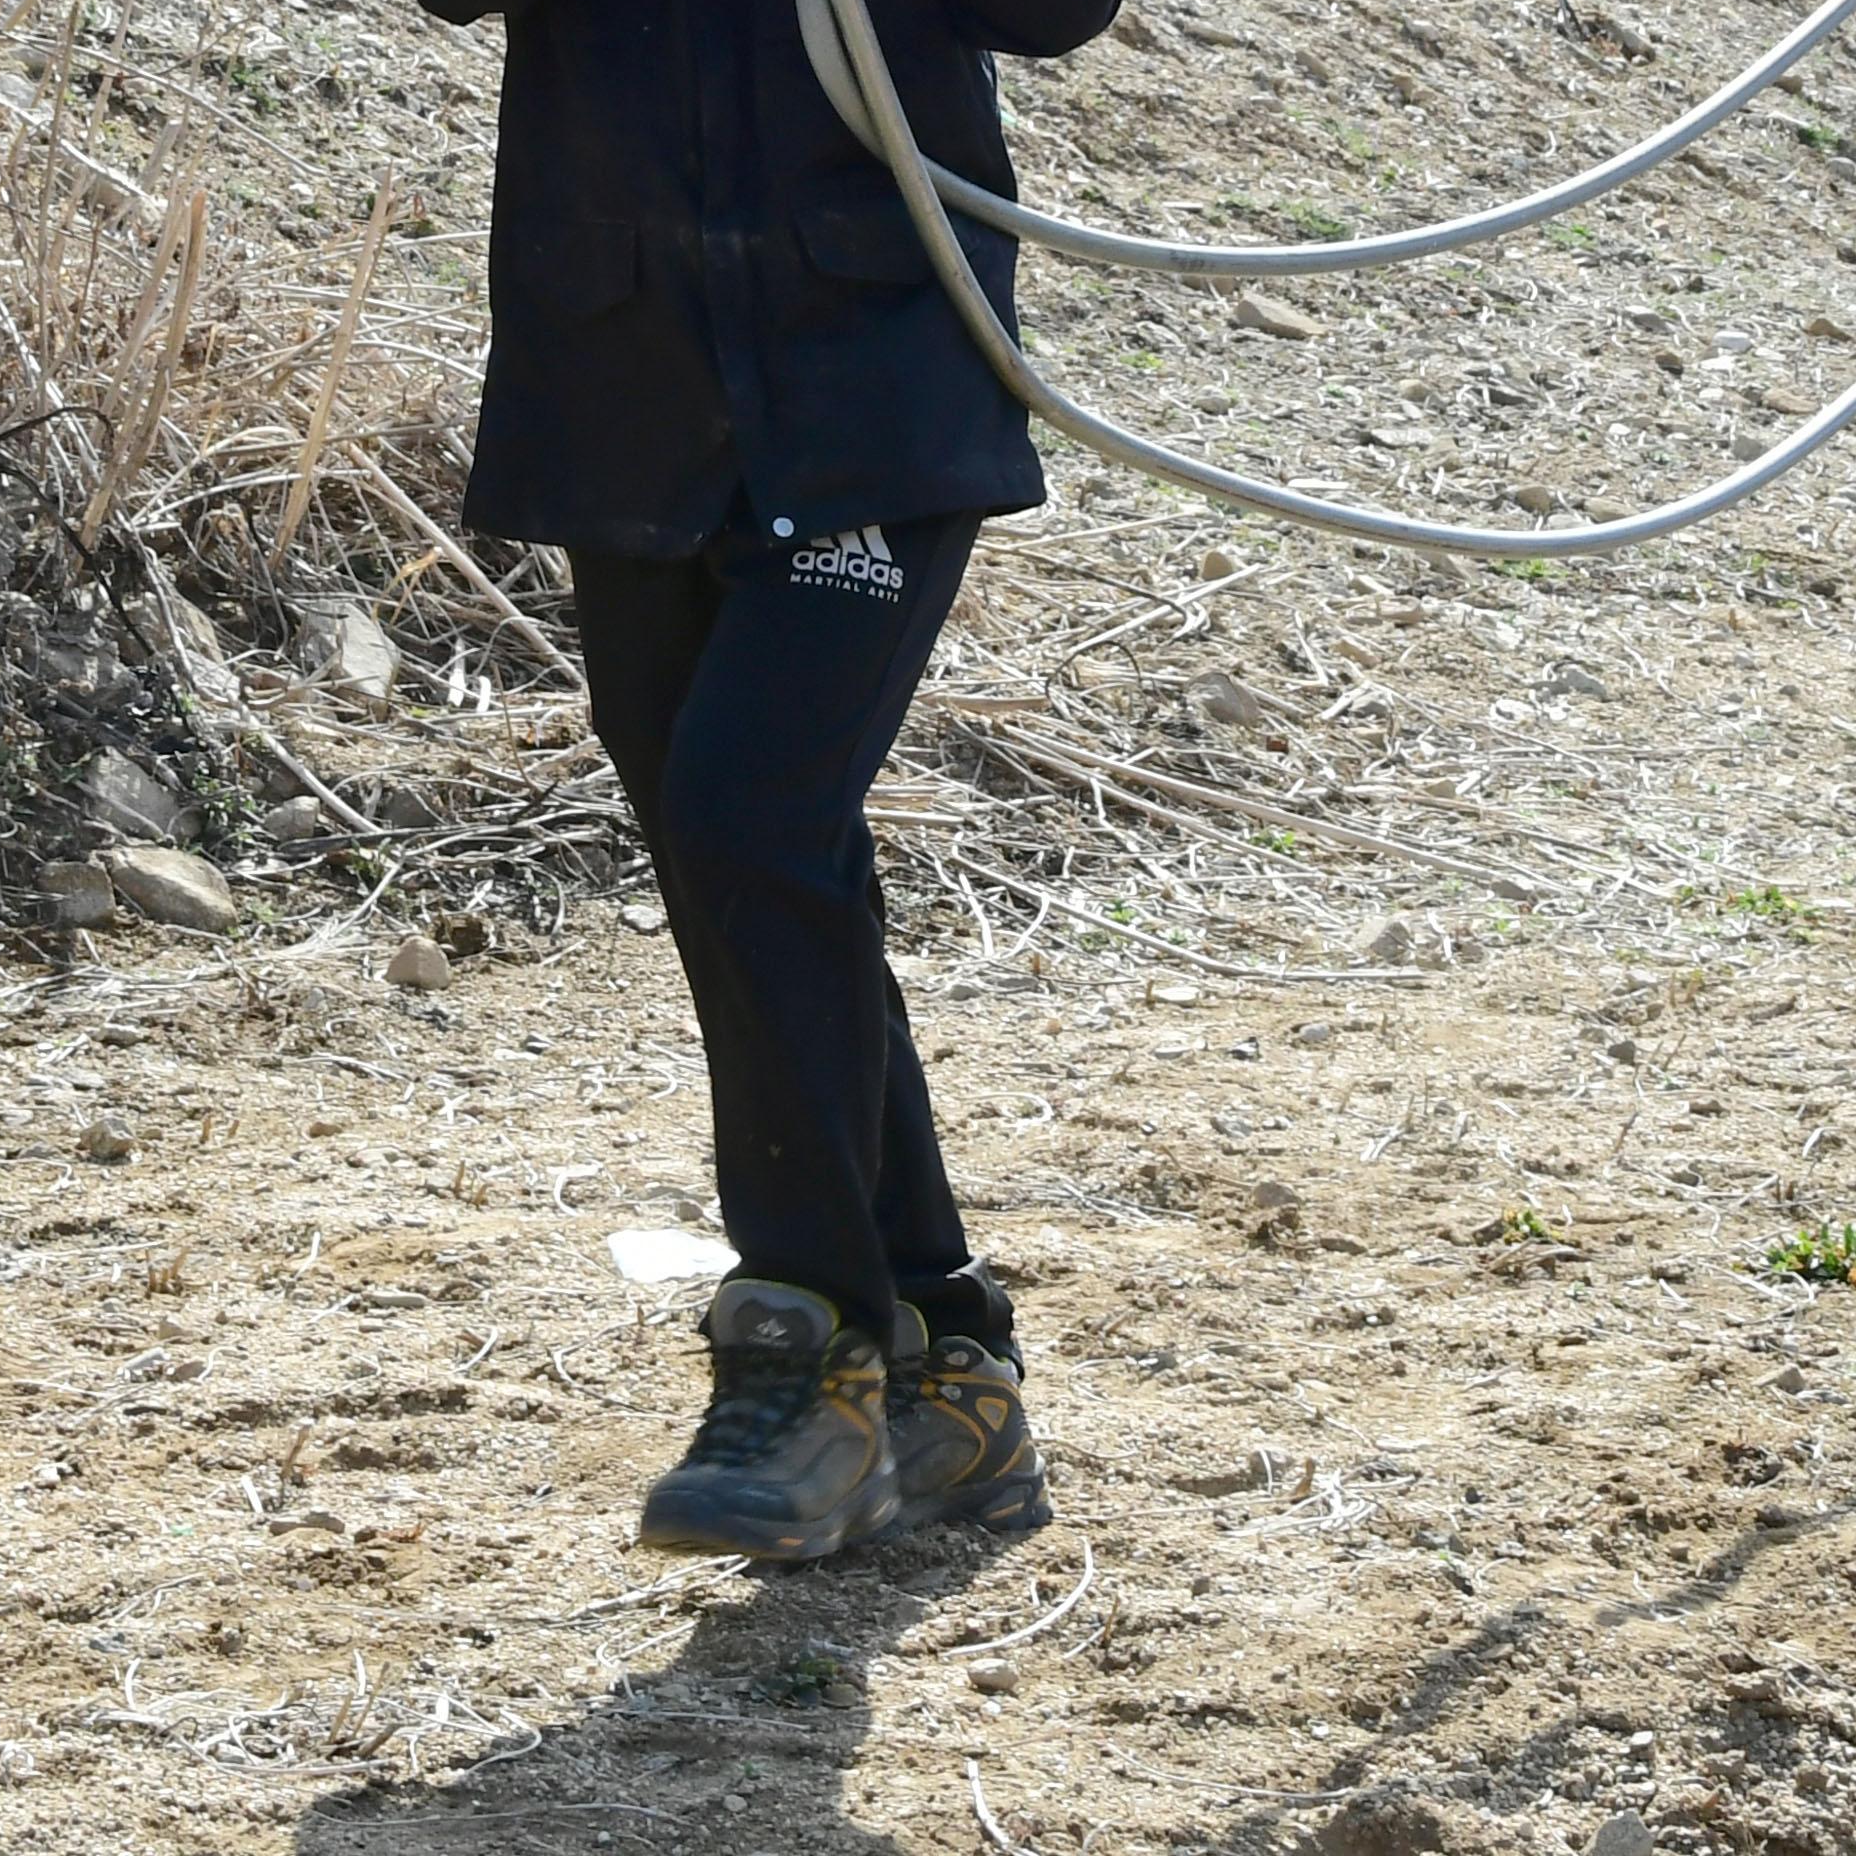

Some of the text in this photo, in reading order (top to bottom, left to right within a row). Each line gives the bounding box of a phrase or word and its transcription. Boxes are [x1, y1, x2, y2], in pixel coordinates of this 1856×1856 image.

[793, 548, 904, 589] adidas
[791, 574, 899, 603] MARTIAL ARTS
